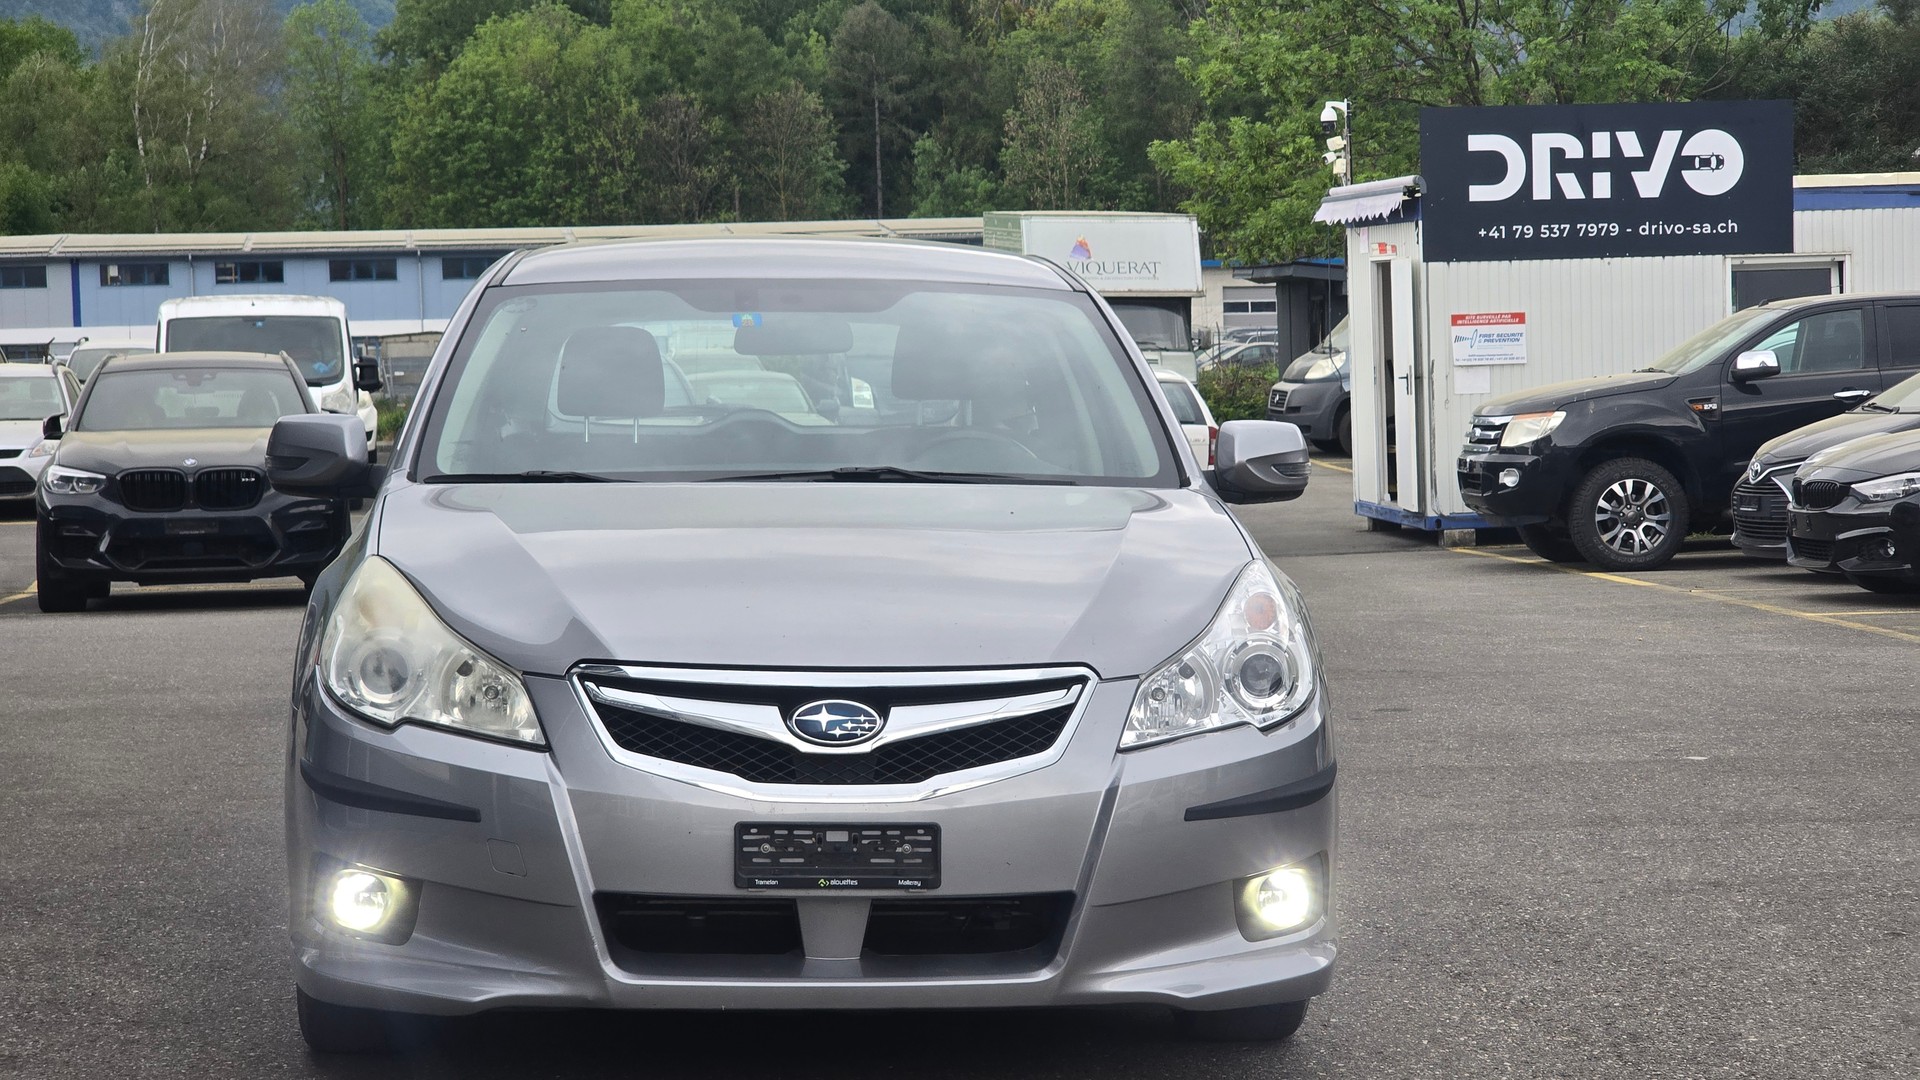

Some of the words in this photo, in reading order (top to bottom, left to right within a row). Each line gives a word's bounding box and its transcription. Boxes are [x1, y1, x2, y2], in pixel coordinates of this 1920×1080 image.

[1467, 129, 1745, 202] DRIVO
[1478, 225, 1506, 239] +41
[1512, 224, 1534, 239] 79
[1540, 224, 1570, 238] 537
[1577, 222, 1619, 237] 7979
[1639, 219, 1738, 236] drivo-sa.ch
[1066, 261, 1161, 275] VIQUERAT
[829, 878, 858, 886] alouettes
